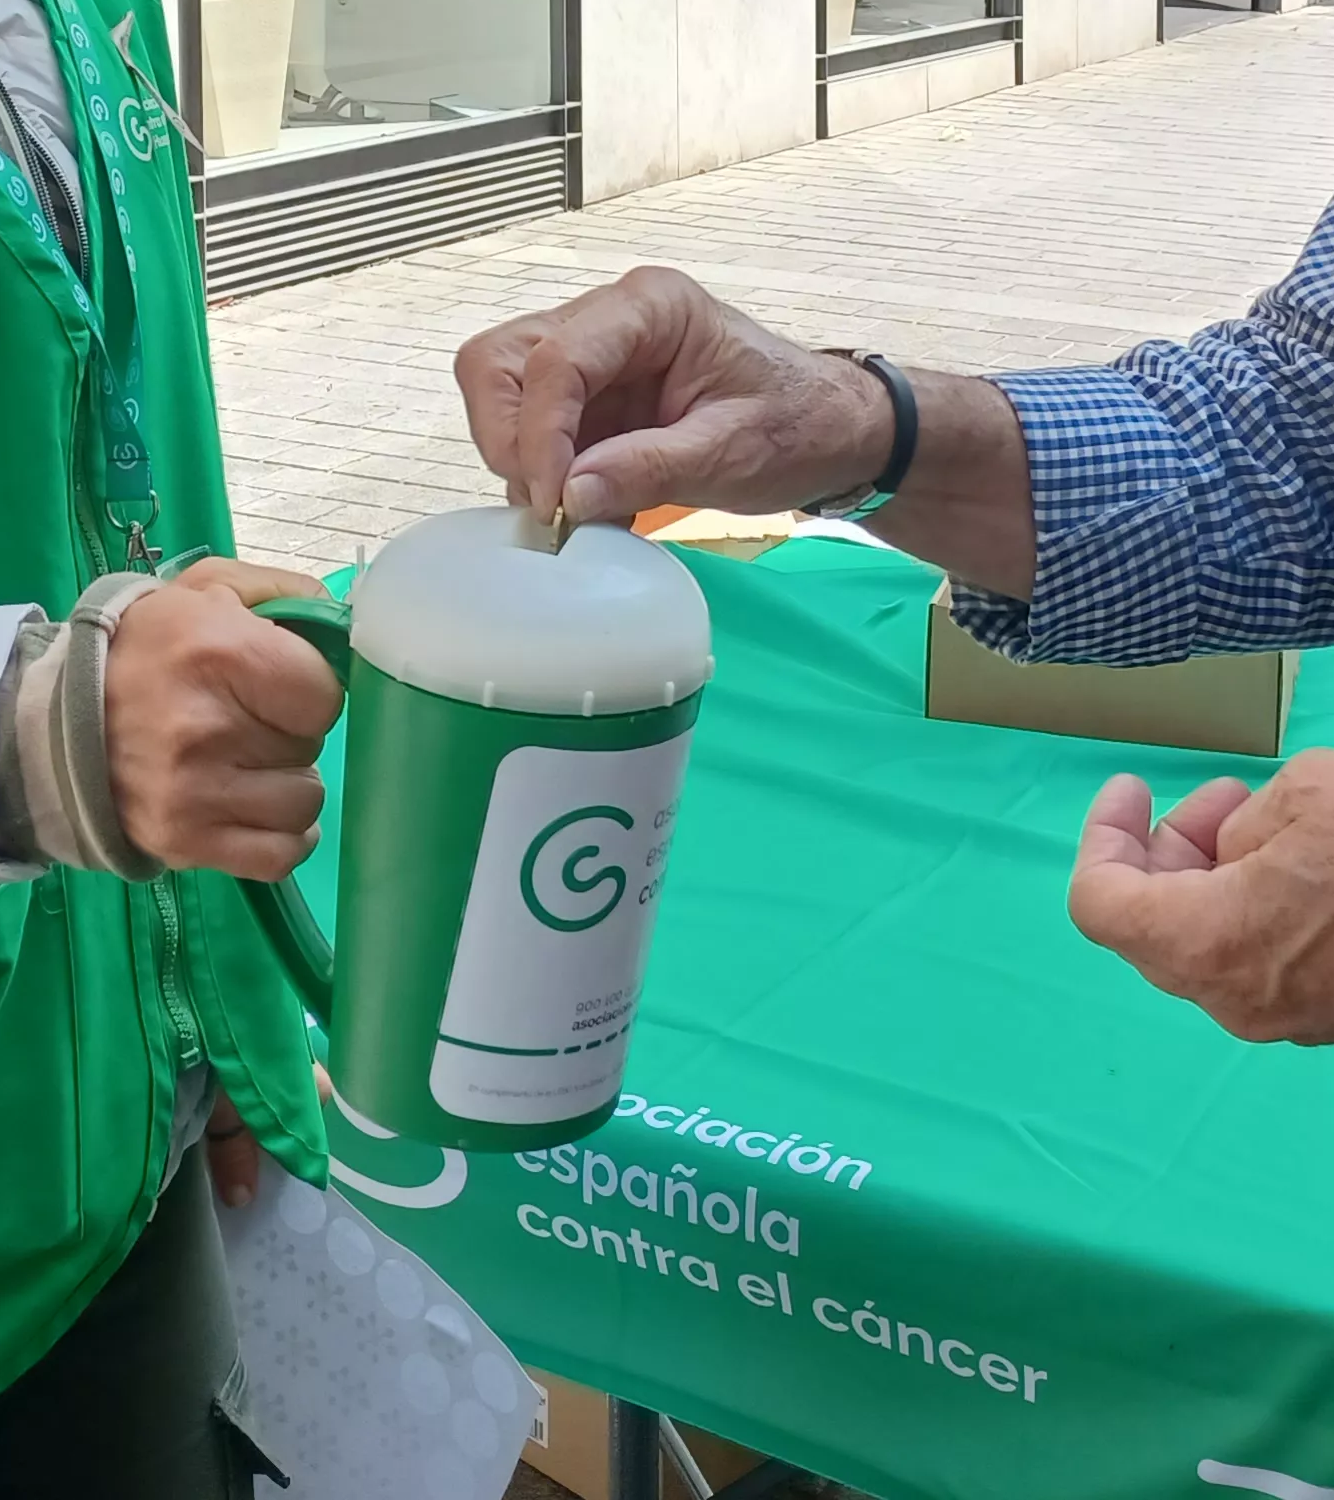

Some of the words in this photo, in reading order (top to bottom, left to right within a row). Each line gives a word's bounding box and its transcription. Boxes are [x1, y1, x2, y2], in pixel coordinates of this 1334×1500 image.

[575, 998, 602, 1016] 900
[612, 1092, 874, 1192] ociación
[513, 1143, 801, 1258] española
[517, 1203, 720, 1293] contra
[737, 1272, 794, 1315] el
[812, 1296, 1049, 1404] cáncer
